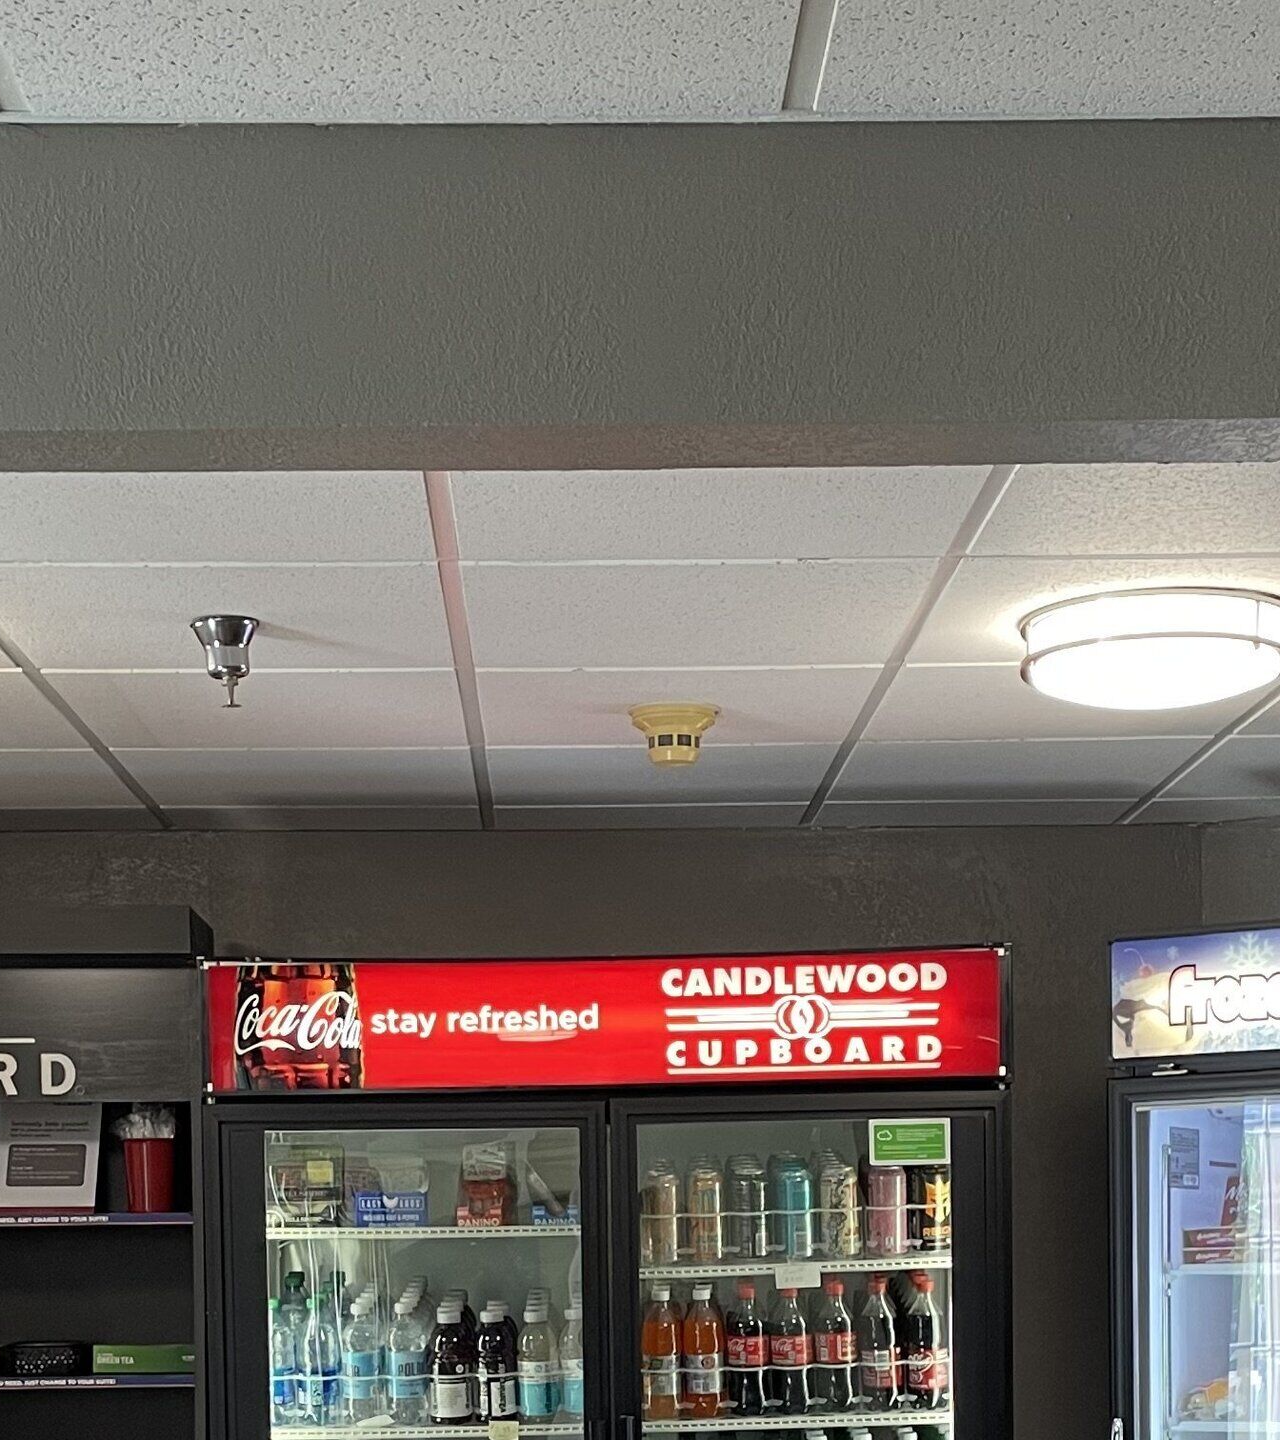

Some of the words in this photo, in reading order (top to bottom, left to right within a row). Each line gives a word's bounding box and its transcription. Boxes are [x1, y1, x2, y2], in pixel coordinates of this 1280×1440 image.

[661, 963, 948, 997] CANDLEWOOD
[234, 991, 362, 1054] Coca-Cola
[371, 1008, 436, 1038] stay
[447, 1003, 598, 1032] refreshed
[667, 1035, 942, 1066] CUPBOARD
[458, 1218, 500, 1226] PANINO
[120, 1356, 134, 1364] TEA
